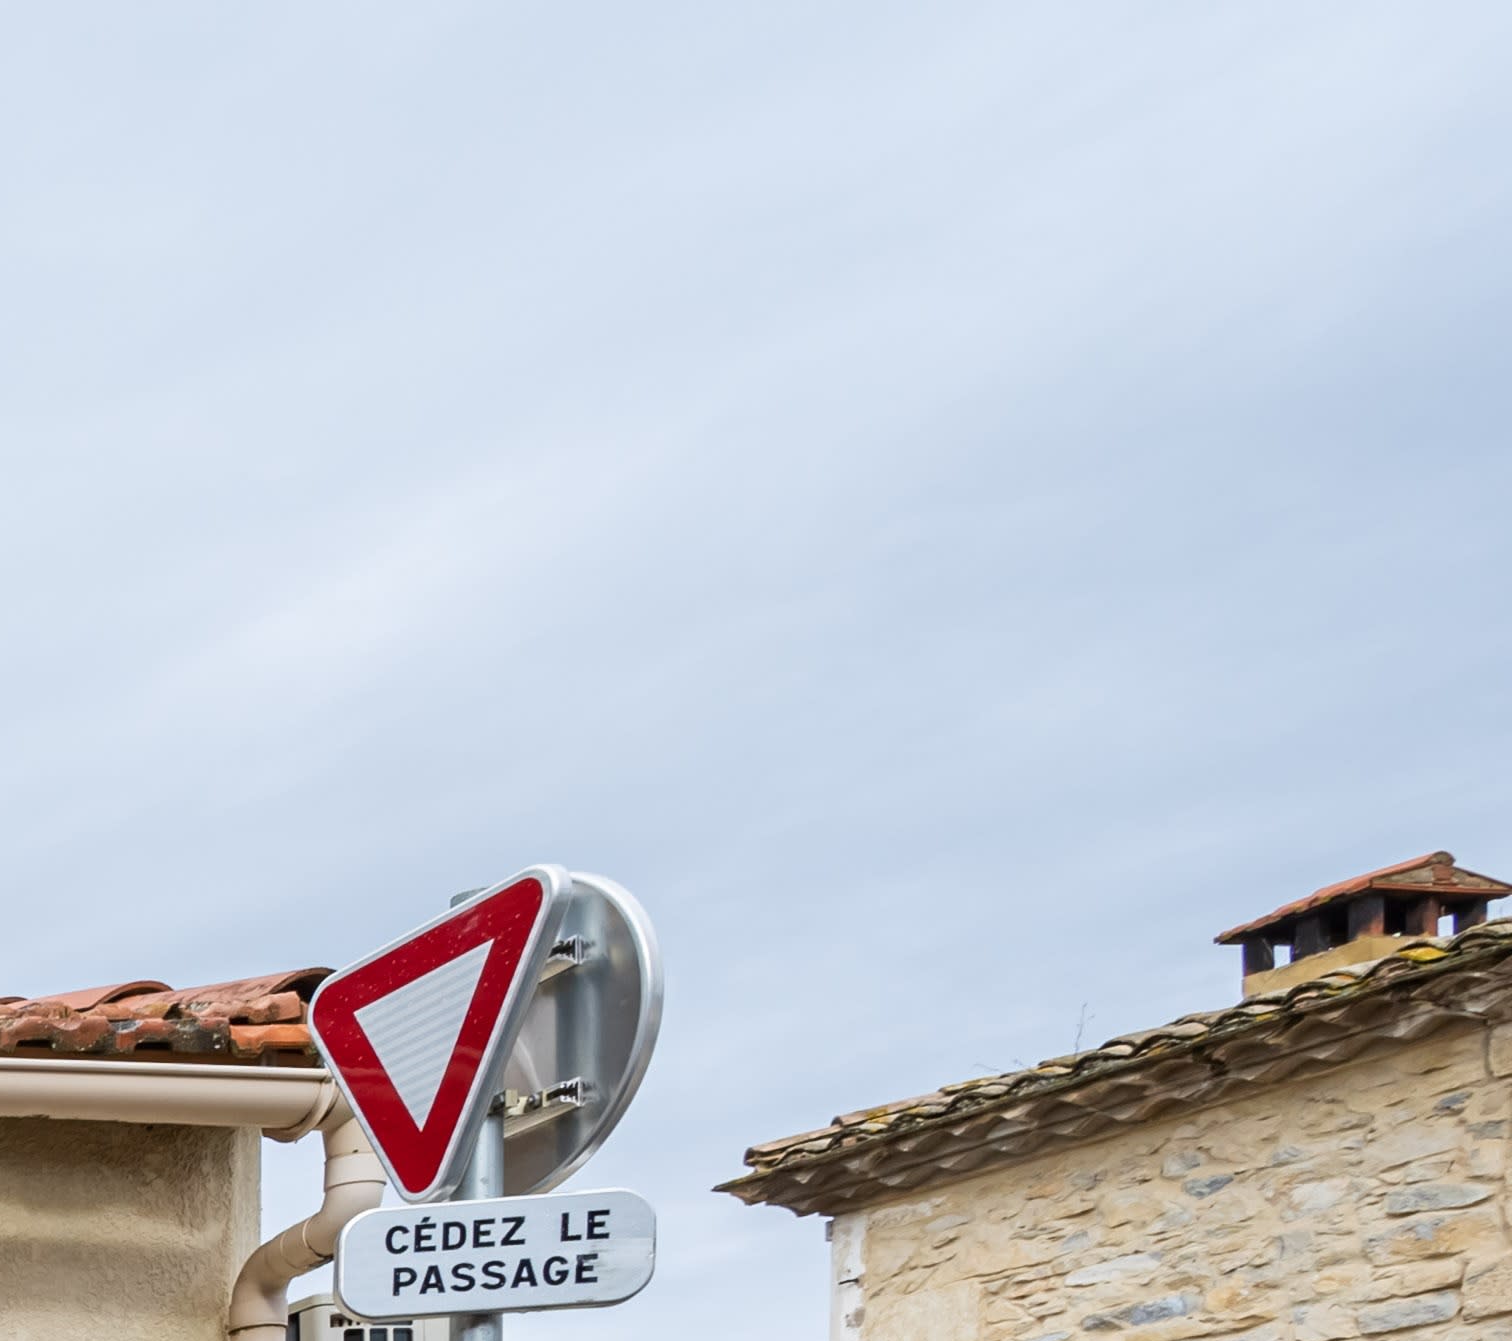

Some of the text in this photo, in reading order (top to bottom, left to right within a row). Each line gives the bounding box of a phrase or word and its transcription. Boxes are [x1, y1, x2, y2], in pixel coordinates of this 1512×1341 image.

[386, 1209, 611, 1254] CÉDEZ LE
[392, 1253, 599, 1296] PASSAGE
